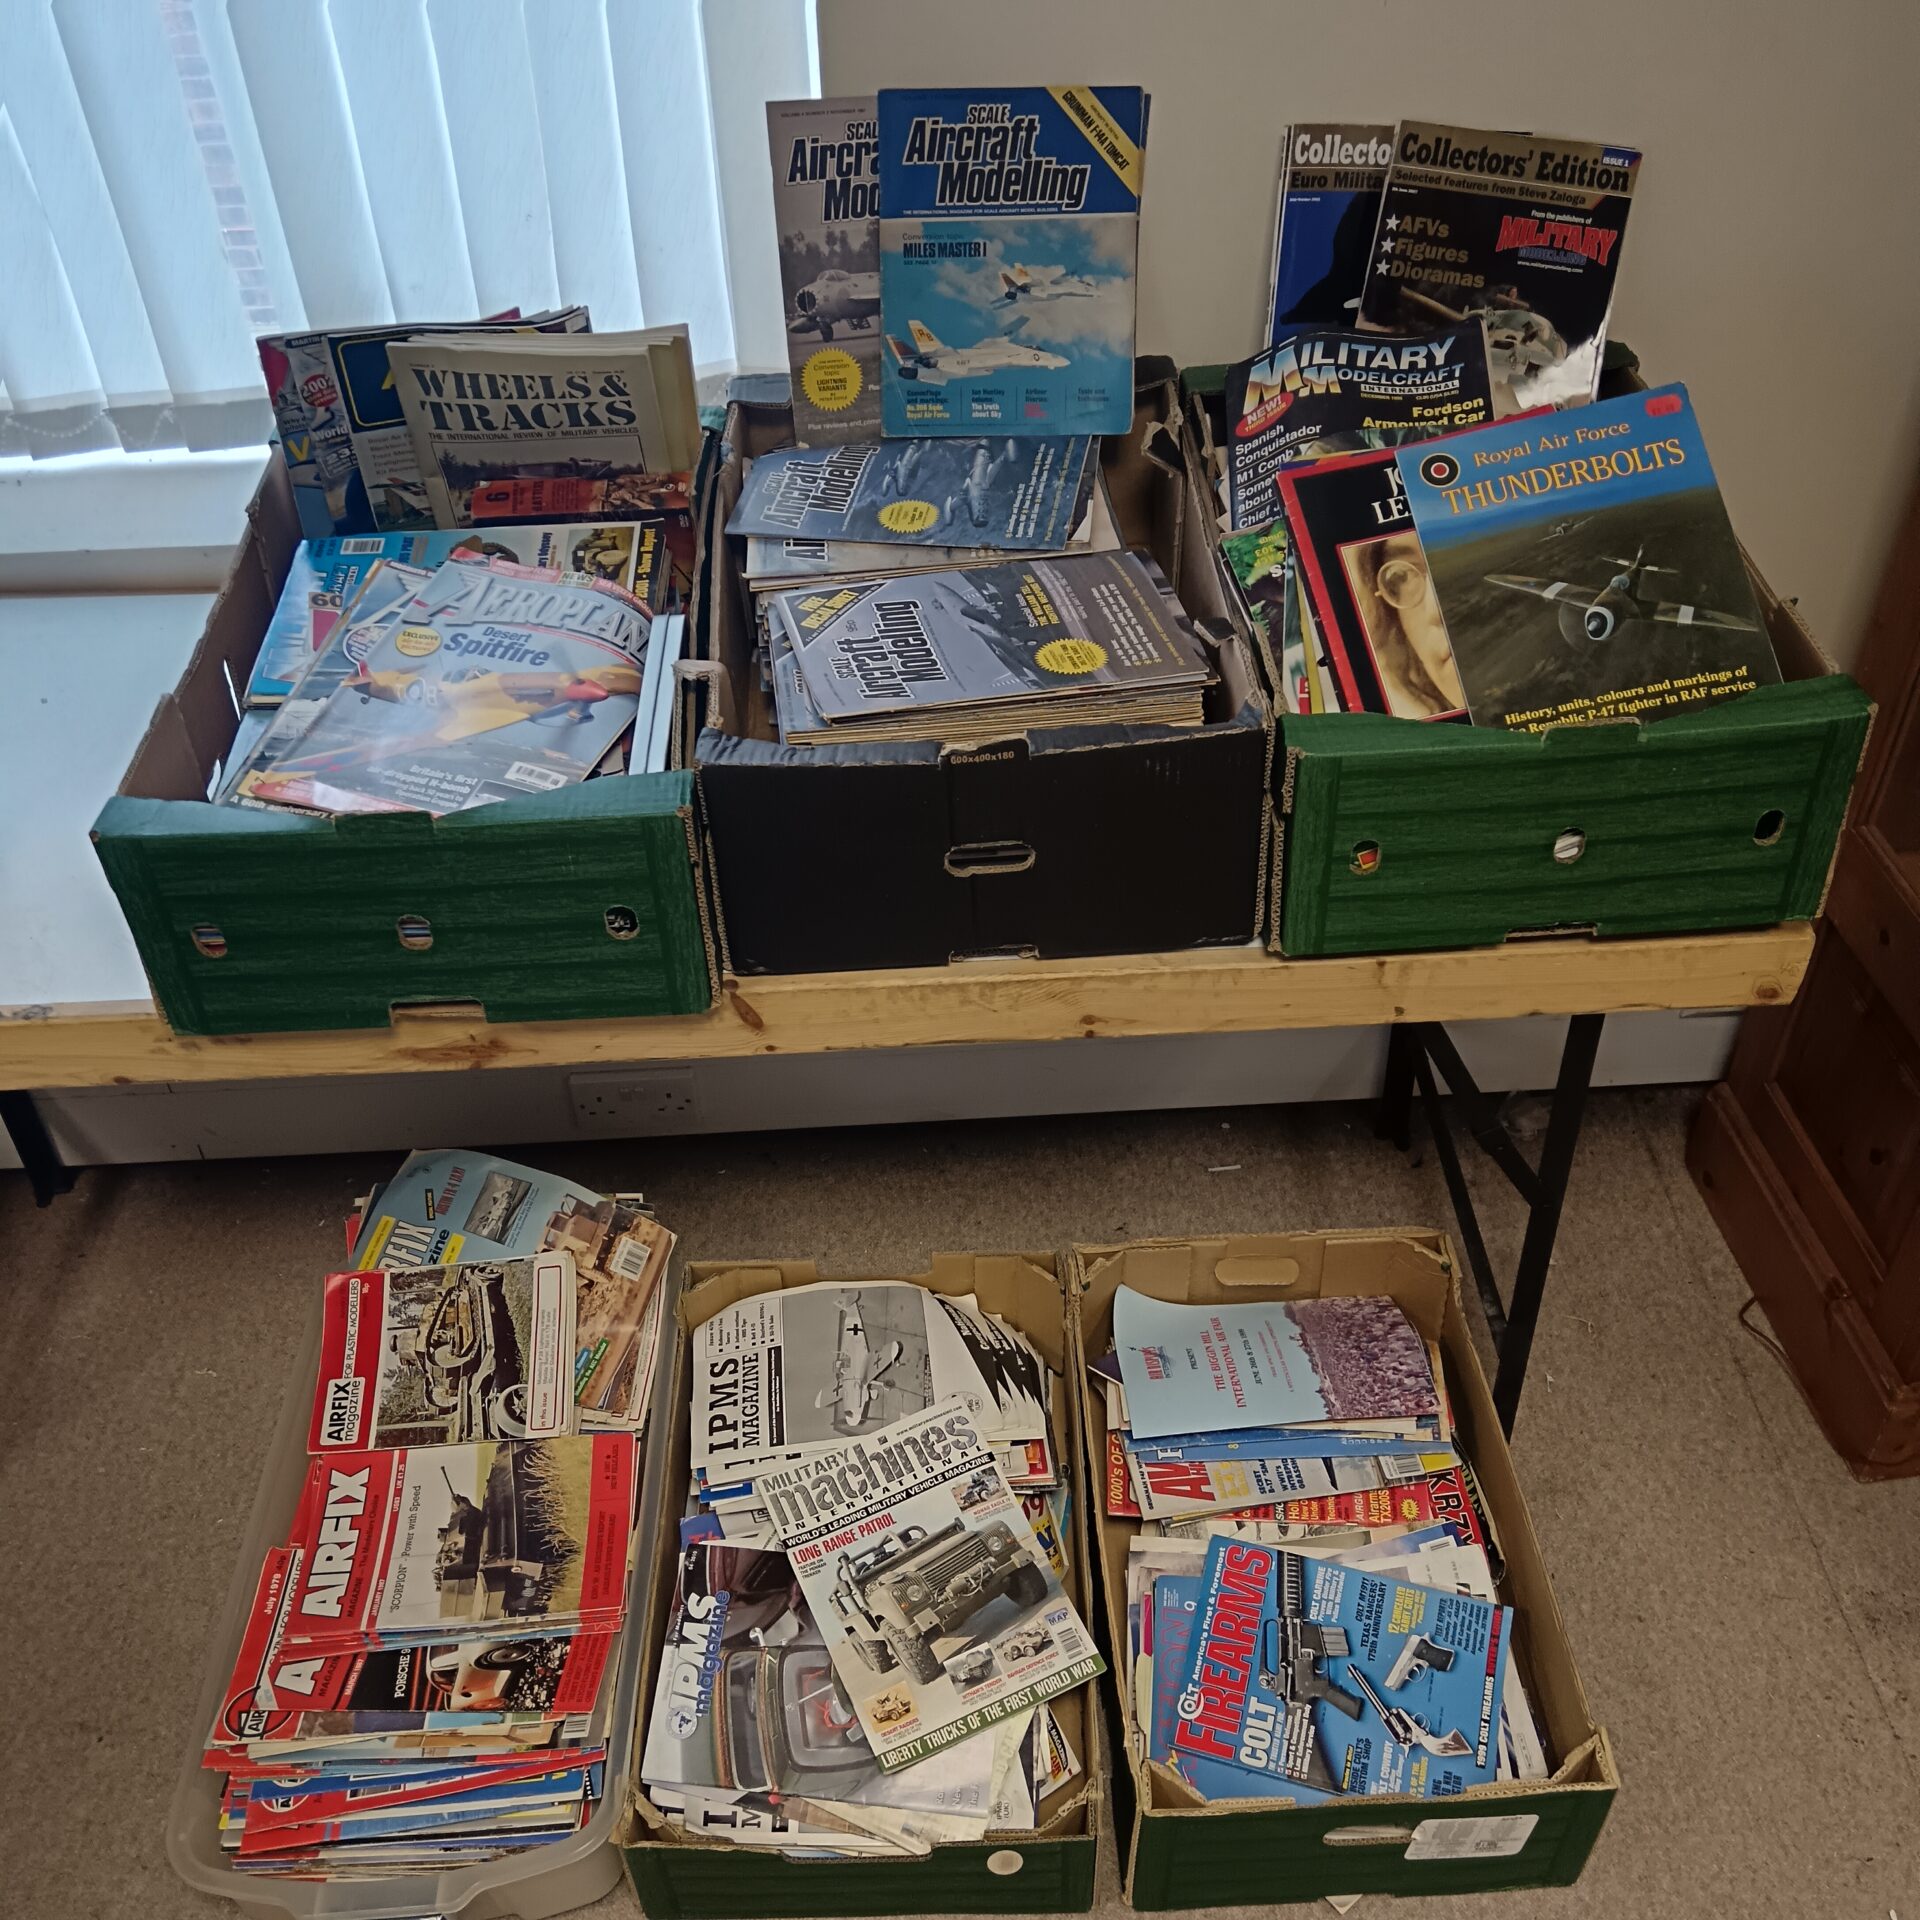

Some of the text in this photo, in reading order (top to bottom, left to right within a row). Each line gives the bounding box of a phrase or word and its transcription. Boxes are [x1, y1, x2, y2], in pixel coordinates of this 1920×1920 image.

[968, 104, 1011, 125] SCALE
[1062, 90, 1095, 129] GRUMMAN
[1103, 140, 1130, 171] TOMCAT
[903, 114, 1040, 165] Aircraft
[1294, 134, 1392, 165] Collecto
[1400, 132, 1630, 192] Collectors' Edition
[1602, 156, 1623, 167] ISSUE
[936, 159, 1091, 210] Modelling
[1291, 171, 1328, 189] Euro
[1396, 170, 1586, 206] Selected features from Steve Zaloga
[1400, 214, 1450, 238] AFVs
[1495, 215, 1618, 267] MILITARY
[903, 242, 981, 258] MILES MASTER
[1395, 238, 1469, 264] Figures
[1390, 260, 1486, 289] Dioramas
[411, 367, 631, 400] WHEELS &
[816, 377, 847, 386] LIGHTNING
[818, 384, 847, 392] VARIANTS
[1242, 335, 1457, 415] MILITARY
[1298, 362, 1465, 398] MODELCRAFT
[1362, 381, 1458, 394] INTERNATIONAL
[420, 399, 637, 432] TRACKS
[1246, 395, 1282, 425] NEW!
[1412, 397, 1484, 418] Fordson
[1454, 411, 1486, 425] Car
[428, 431, 443, 440] THE
[446, 432, 510, 441] INTERNATIONAL
[513, 431, 543, 440] REVIEW
[561, 429, 598, 438] MILITARY
[603, 426, 639, 435] VEHICLES
[1235, 424, 1284, 456] Spanish
[1236, 425, 1322, 468] Conquistador
[1473, 421, 1631, 468] Royal Air Force
[760, 460, 826, 529] Aircraft
[763, 472, 786, 494] SCALE
[807, 445, 881, 513] Modelling
[1236, 470, 1254, 485] M1
[1441, 438, 1686, 515] THUNDERBOLTS
[486, 491, 510, 503] 6
[1238, 488, 1273, 513] about
[1239, 505, 1271, 529] Chief
[640, 528, 657, 552] Report
[561, 570, 594, 582] NEWS
[402, 630, 439, 641] EXCLUSIVE
[443, 631, 550, 667] Spitfire
[482, 625, 532, 643] Desert
[872, 599, 950, 683] Modelling
[828, 657, 858, 680] SCALE
[834, 636, 915, 700] Aircraft
[1504, 665, 1748, 726] History, units, colours and markings of
[1588, 679, 1757, 719] P-47 fighter in RAF service
[950, 750, 1015, 765] 600x400x180
[266, 802, 332, 819] anniversary
[427, 1228, 450, 1264] zine
[344, 1280, 360, 1379] FOR PLASTIC MODELLERS
[1185, 1347, 1199, 1370] PRESENT
[1199, 1330, 1226, 1392] THE BIGGIN HILL
[1210, 1316, 1247, 1408] INTERNATIONAL AIR FAIR
[1251, 1370, 1263, 1385] JUNE
[327, 1382, 351, 1442] AIRFIX
[344, 1380, 361, 1442] magazine
[539, 1408, 547, 1420] this
[708, 1357, 739, 1455] IPMS
[741, 1352, 760, 1449] MAGAZINE
[761, 1447, 852, 1494] MILITARY
[768, 1415, 978, 1526] machines
[1110, 1441, 1125, 1505] 1000's OF
[1253, 1470, 1267, 1495] SECRET
[1263, 1477, 1276, 1494] B-17
[782, 1445, 984, 1535] INTERNATIONAL
[785, 1454, 991, 1547] WORLD'S LEADING MILITARY VEHICLE MAGAZINE
[301, 1464, 372, 1619] AIRFIX
[389, 1485, 422, 1614] "SCORPION" Power with Speed
[792, 1512, 897, 1565] LONG RANGE PATROL
[263, 1572, 282, 1616] July 1979
[346, 1576, 364, 1618] MAGAZINE
[371, 1590, 383, 1617] JANUARY
[1309, 1566, 1327, 1621] COLT CARBINE
[1355, 1577, 1370, 1622] COLT M1911
[675, 1604, 685, 1630] Modellers
[1047, 1610, 1069, 1626] MAP
[1191, 1546, 1226, 1682] America's First & Foremost
[1360, 1579, 1379, 1648] TEXAS RANGERS'
[1367, 1581, 1388, 1662] 175th ANNIVERSARY
[1388, 1622, 1400, 1634] 12
[669, 1591, 718, 1710] IPMS
[695, 1589, 731, 1717] magazine
[1174, 1544, 1273, 1760] FIREARMS
[344, 1675, 359, 1697] MARCH
[394, 1656, 410, 1699] PORSCHE
[880, 1742, 923, 1769] LIBERTY
[925, 1720, 968, 1750] TRUCKS
[967, 1712, 982, 1729] OF
[981, 1703, 1005, 1723] THE
[1004, 1687, 1034, 1712] FIRST
[1034, 1670, 1072, 1697] WORLD
[1071, 1658, 1097, 1681] WAR
[880, 1725, 899, 1738] DESERT
[898, 1717, 919, 1730] RAIDERS
[1476, 1675, 1495, 1767] 1999 COLT FIREARMS
[1239, 1696, 1278, 1769] COLT
[1354, 1737, 1365, 1765] COLT'S
[1357, 1737, 1373, 1795] CUSTOM SHOP
[1381, 1740, 1394, 1773] COWBOY
